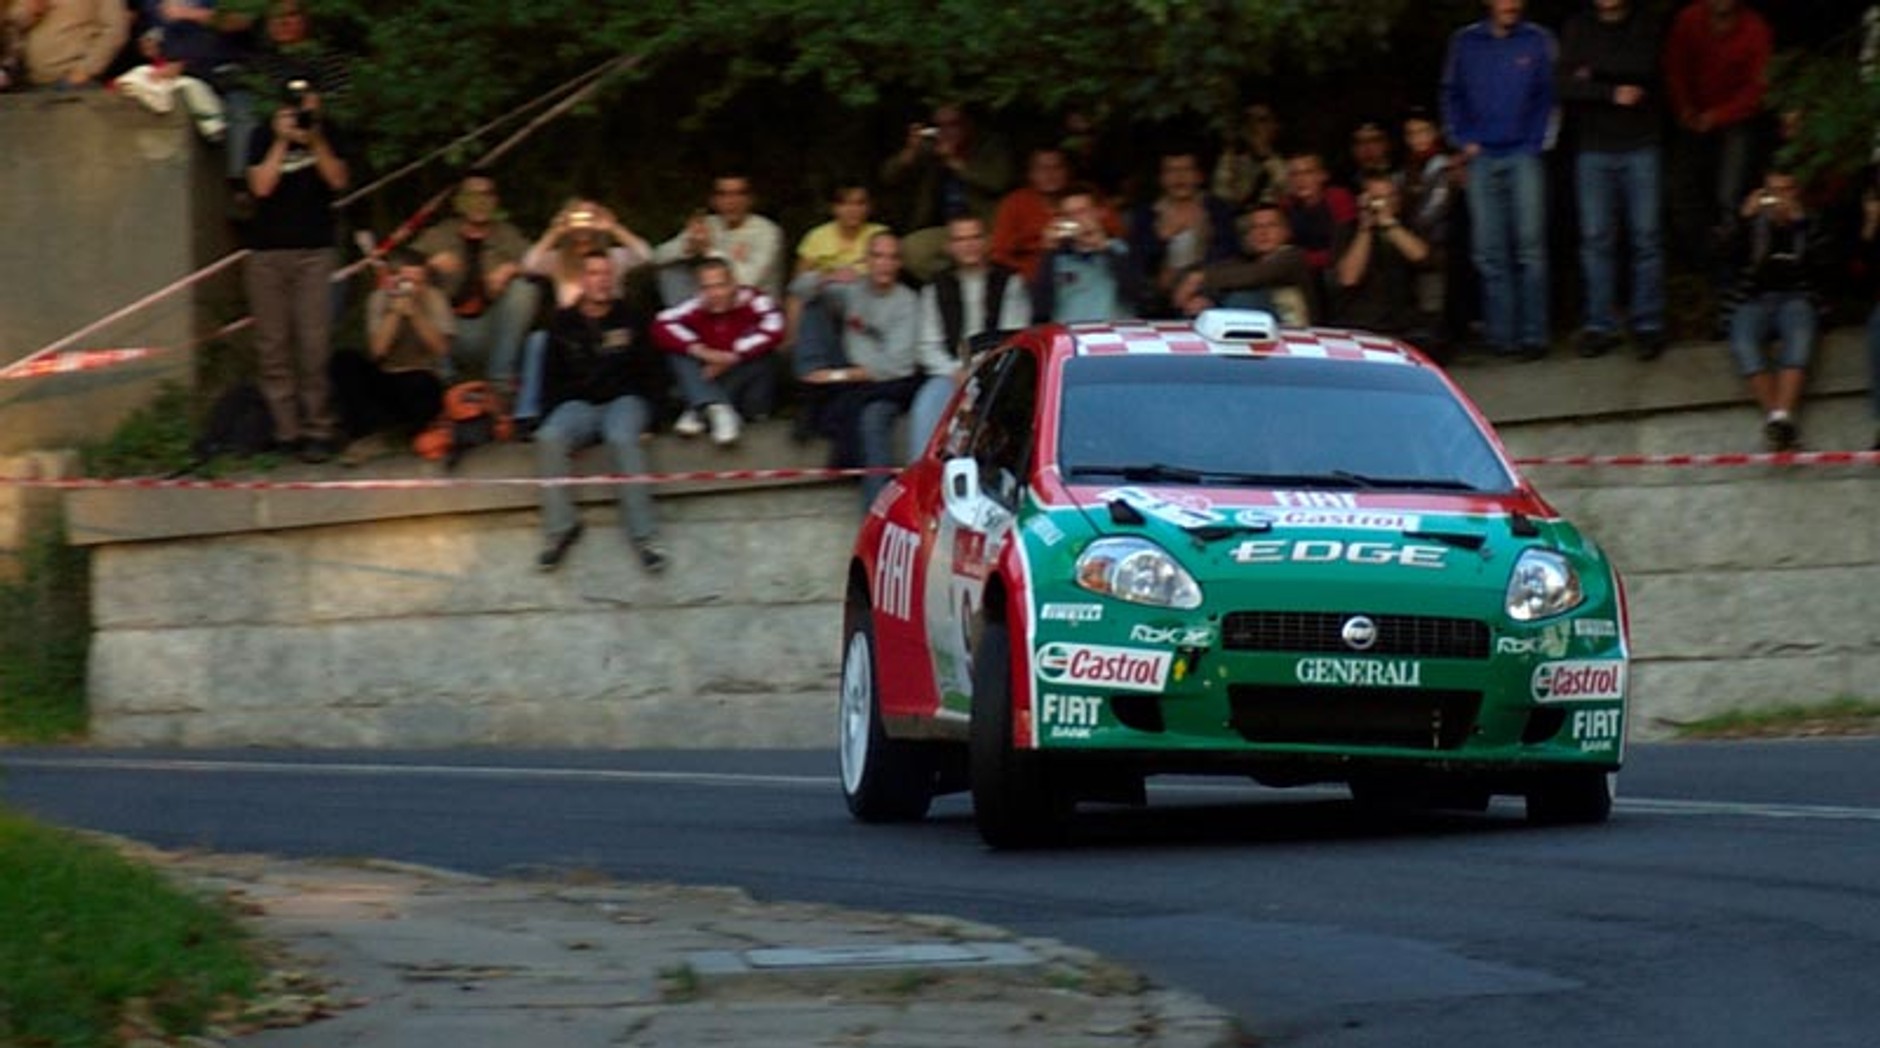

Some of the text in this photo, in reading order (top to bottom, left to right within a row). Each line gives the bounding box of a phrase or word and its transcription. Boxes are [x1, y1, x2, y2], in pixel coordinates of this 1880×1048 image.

[1272, 490, 1357, 508] FIAT
[1284, 511, 1406, 528] Castrol
[1229, 539, 1449, 567] EDGE
[874, 521, 921, 622] FIAT
[1069, 649, 1163, 685] Castrol
[1296, 658, 1421, 687] GENERALI
[1552, 664, 1619, 697] Castrol
[1042, 693, 1103, 726] FIAT
[1572, 709, 1620, 739] FIAT
